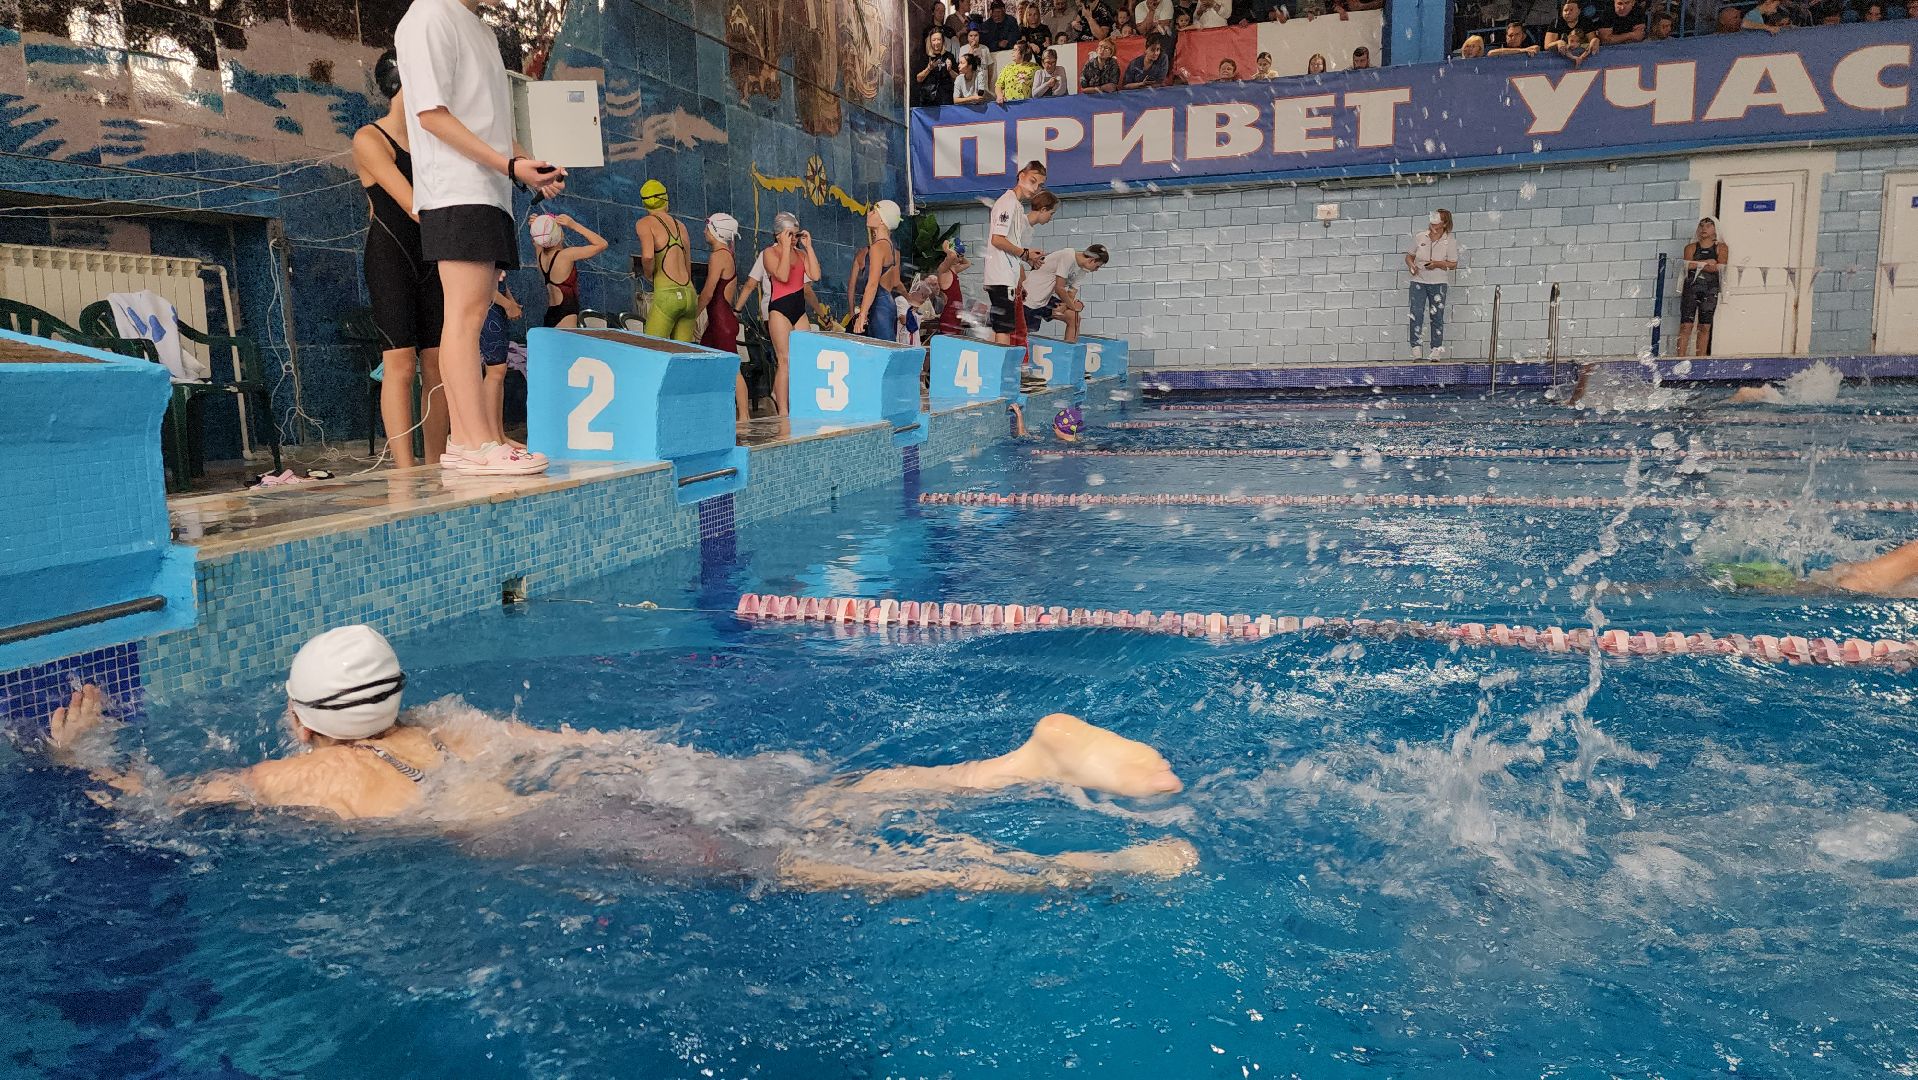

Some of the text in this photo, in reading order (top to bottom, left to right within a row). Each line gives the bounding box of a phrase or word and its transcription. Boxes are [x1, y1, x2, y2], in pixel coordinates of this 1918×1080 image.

[933, 44, 1911, 177] ПРИВЕТ УЧАС
[816, 350, 850, 411] 3
[954, 350, 982, 393] 4
[1031, 345, 1053, 381] 5
[1085, 343, 1103, 372] 6
[567, 357, 615, 451] 2
